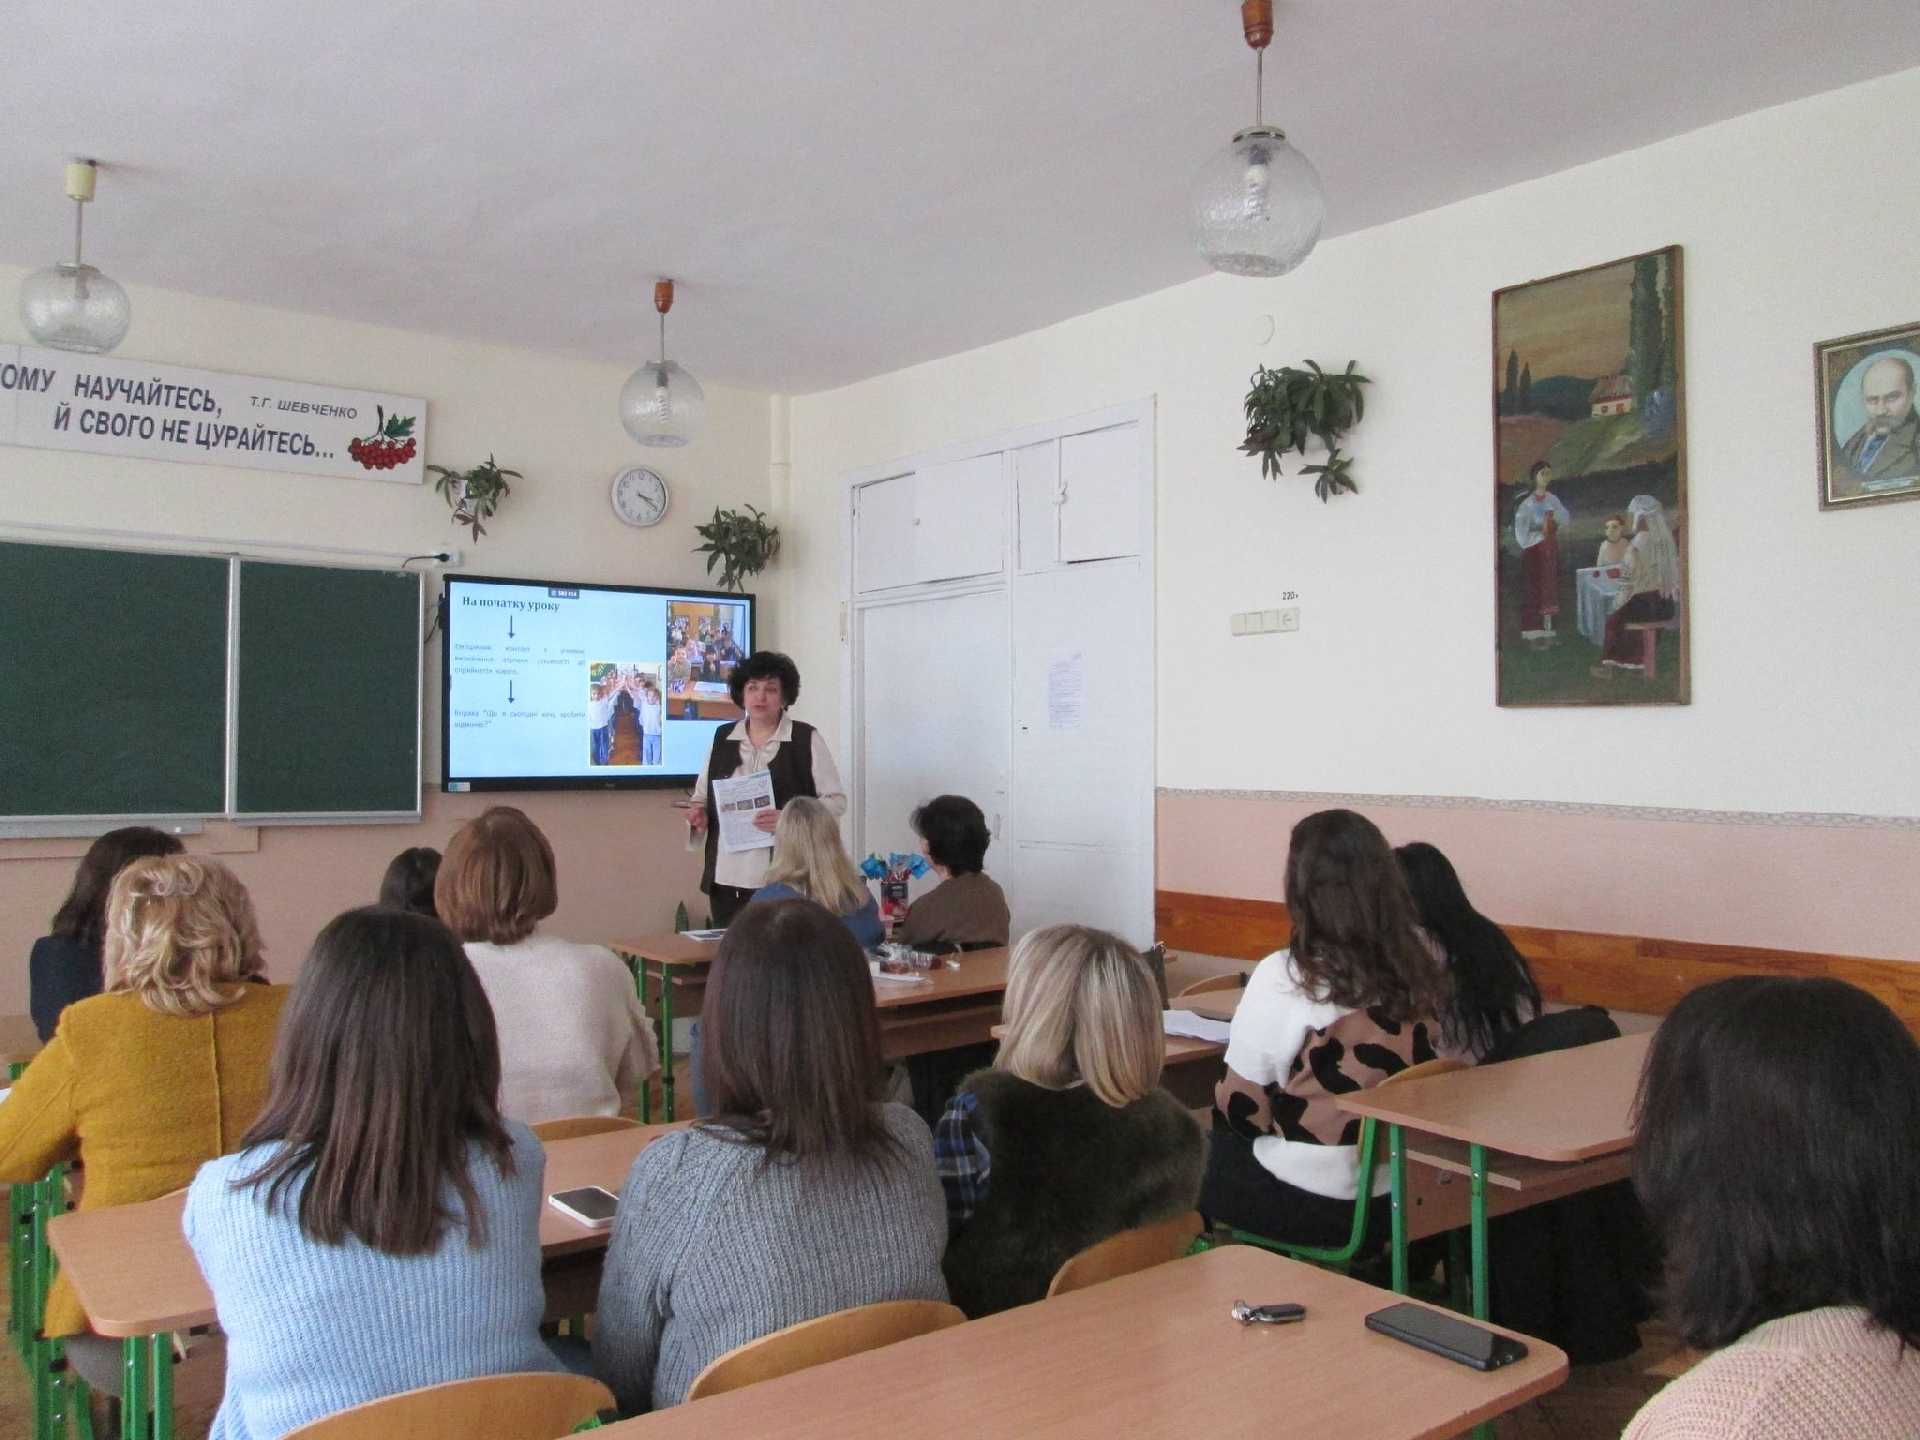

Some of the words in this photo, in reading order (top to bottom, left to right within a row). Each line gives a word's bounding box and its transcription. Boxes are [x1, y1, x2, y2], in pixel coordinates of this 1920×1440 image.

[0, 362, 57, 392] ОМУ
[74, 373, 223, 417] НАУЧАЙТЕСЬ,
[250, 395, 272, 409] Т.Г.
[277, 399, 358, 420] ШЕВЧЕНКО
[54, 402, 72, 432] Й
[79, 409, 155, 441] СВОГО
[161, 416, 189, 444] НЕ
[195, 422, 335, 460] ЦУРАЙТЕСЬ...
[462, 596, 478, 607] На
[479, 598, 526, 612] початку
[527, 600, 561, 613] уроку
